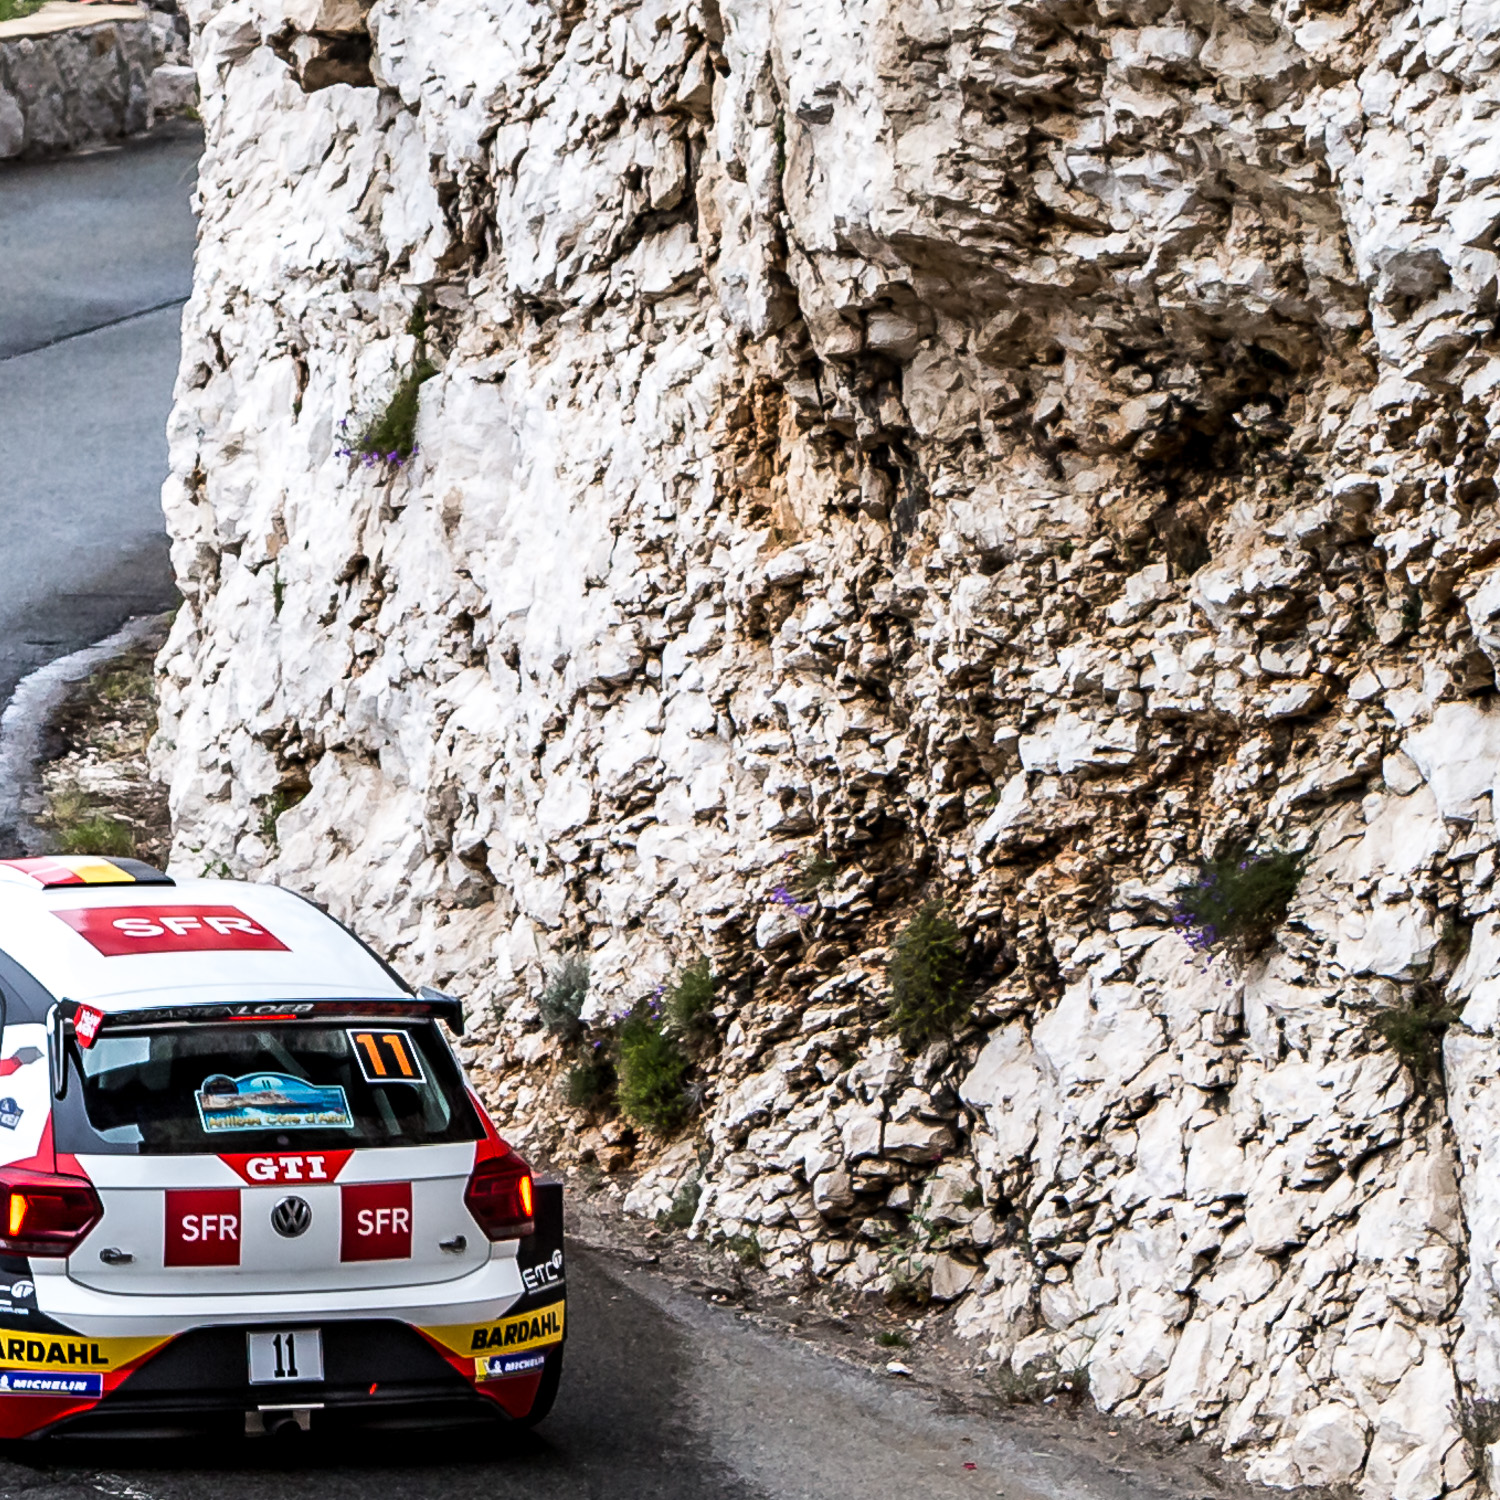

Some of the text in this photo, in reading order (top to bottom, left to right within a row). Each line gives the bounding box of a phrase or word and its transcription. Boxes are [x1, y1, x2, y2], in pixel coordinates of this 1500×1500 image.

[112, 916, 264, 938] SFR
[238, 1003, 315, 1014] LOEB
[356, 1034, 414, 1076] 11
[261, 1079, 272, 1090] 11
[246, 1155, 328, 1180] GTI
[181, 1214, 238, 1242] SFR
[357, 1207, 410, 1237] SFR
[521, 1261, 558, 1289] ETC
[471, 1311, 560, 1351] BARDAHL
[273, 1333, 298, 1378] 11
[504, 1356, 545, 1373] MICHELIN
[12, 1379, 87, 1391] MICHELIN
